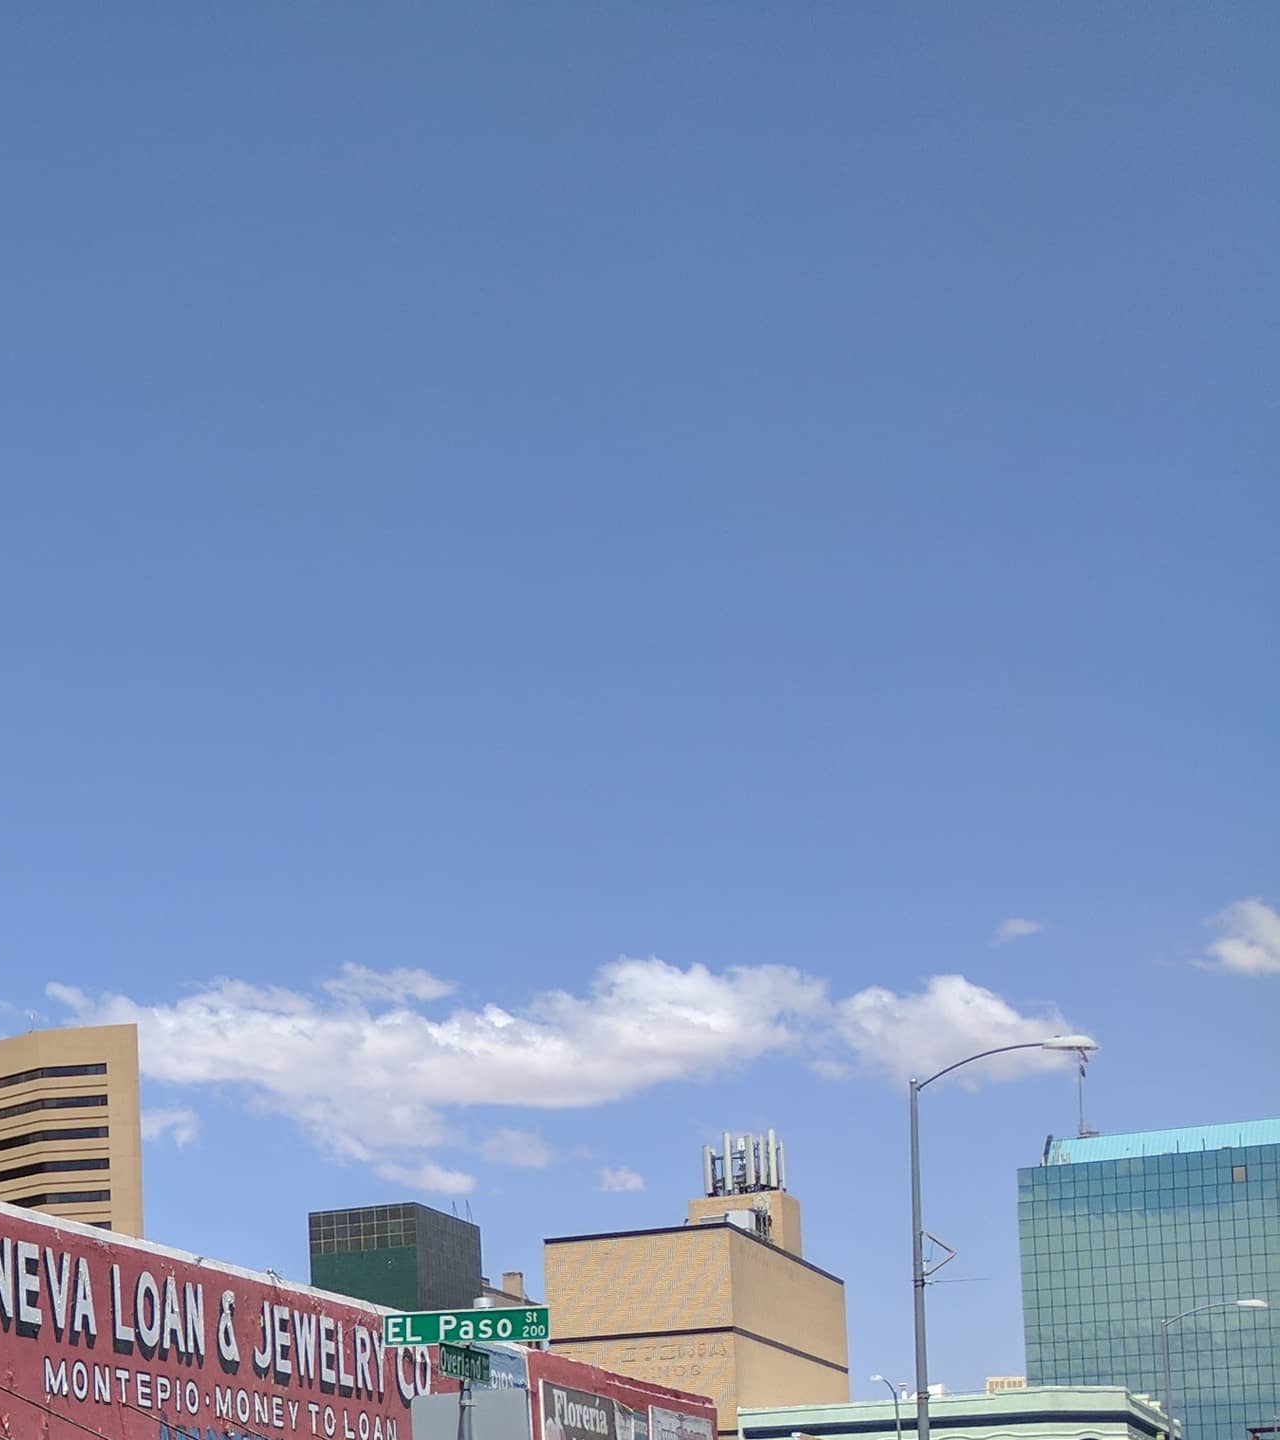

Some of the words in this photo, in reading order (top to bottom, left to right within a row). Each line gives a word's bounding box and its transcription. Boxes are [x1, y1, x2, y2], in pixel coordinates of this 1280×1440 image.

[112, 1264, 206, 1356] LOAN
[217, 1289, 240, 1362] &
[252, 1302, 384, 1393] JEWELRY
[387, 1317, 423, 1343] EL
[439, 1314, 513, 1341] Paso
[522, 1324, 547, 1338] 200
[525, 1311, 538, 1323] St
[440, 1346, 482, 1380] Overland
[44, 1356, 198, 1416] MONTEPIO
[214, 1391, 299, 1431] MONEY
[309, 1403, 337, 1437] TO
[552, 1388, 609, 1436] Florería
